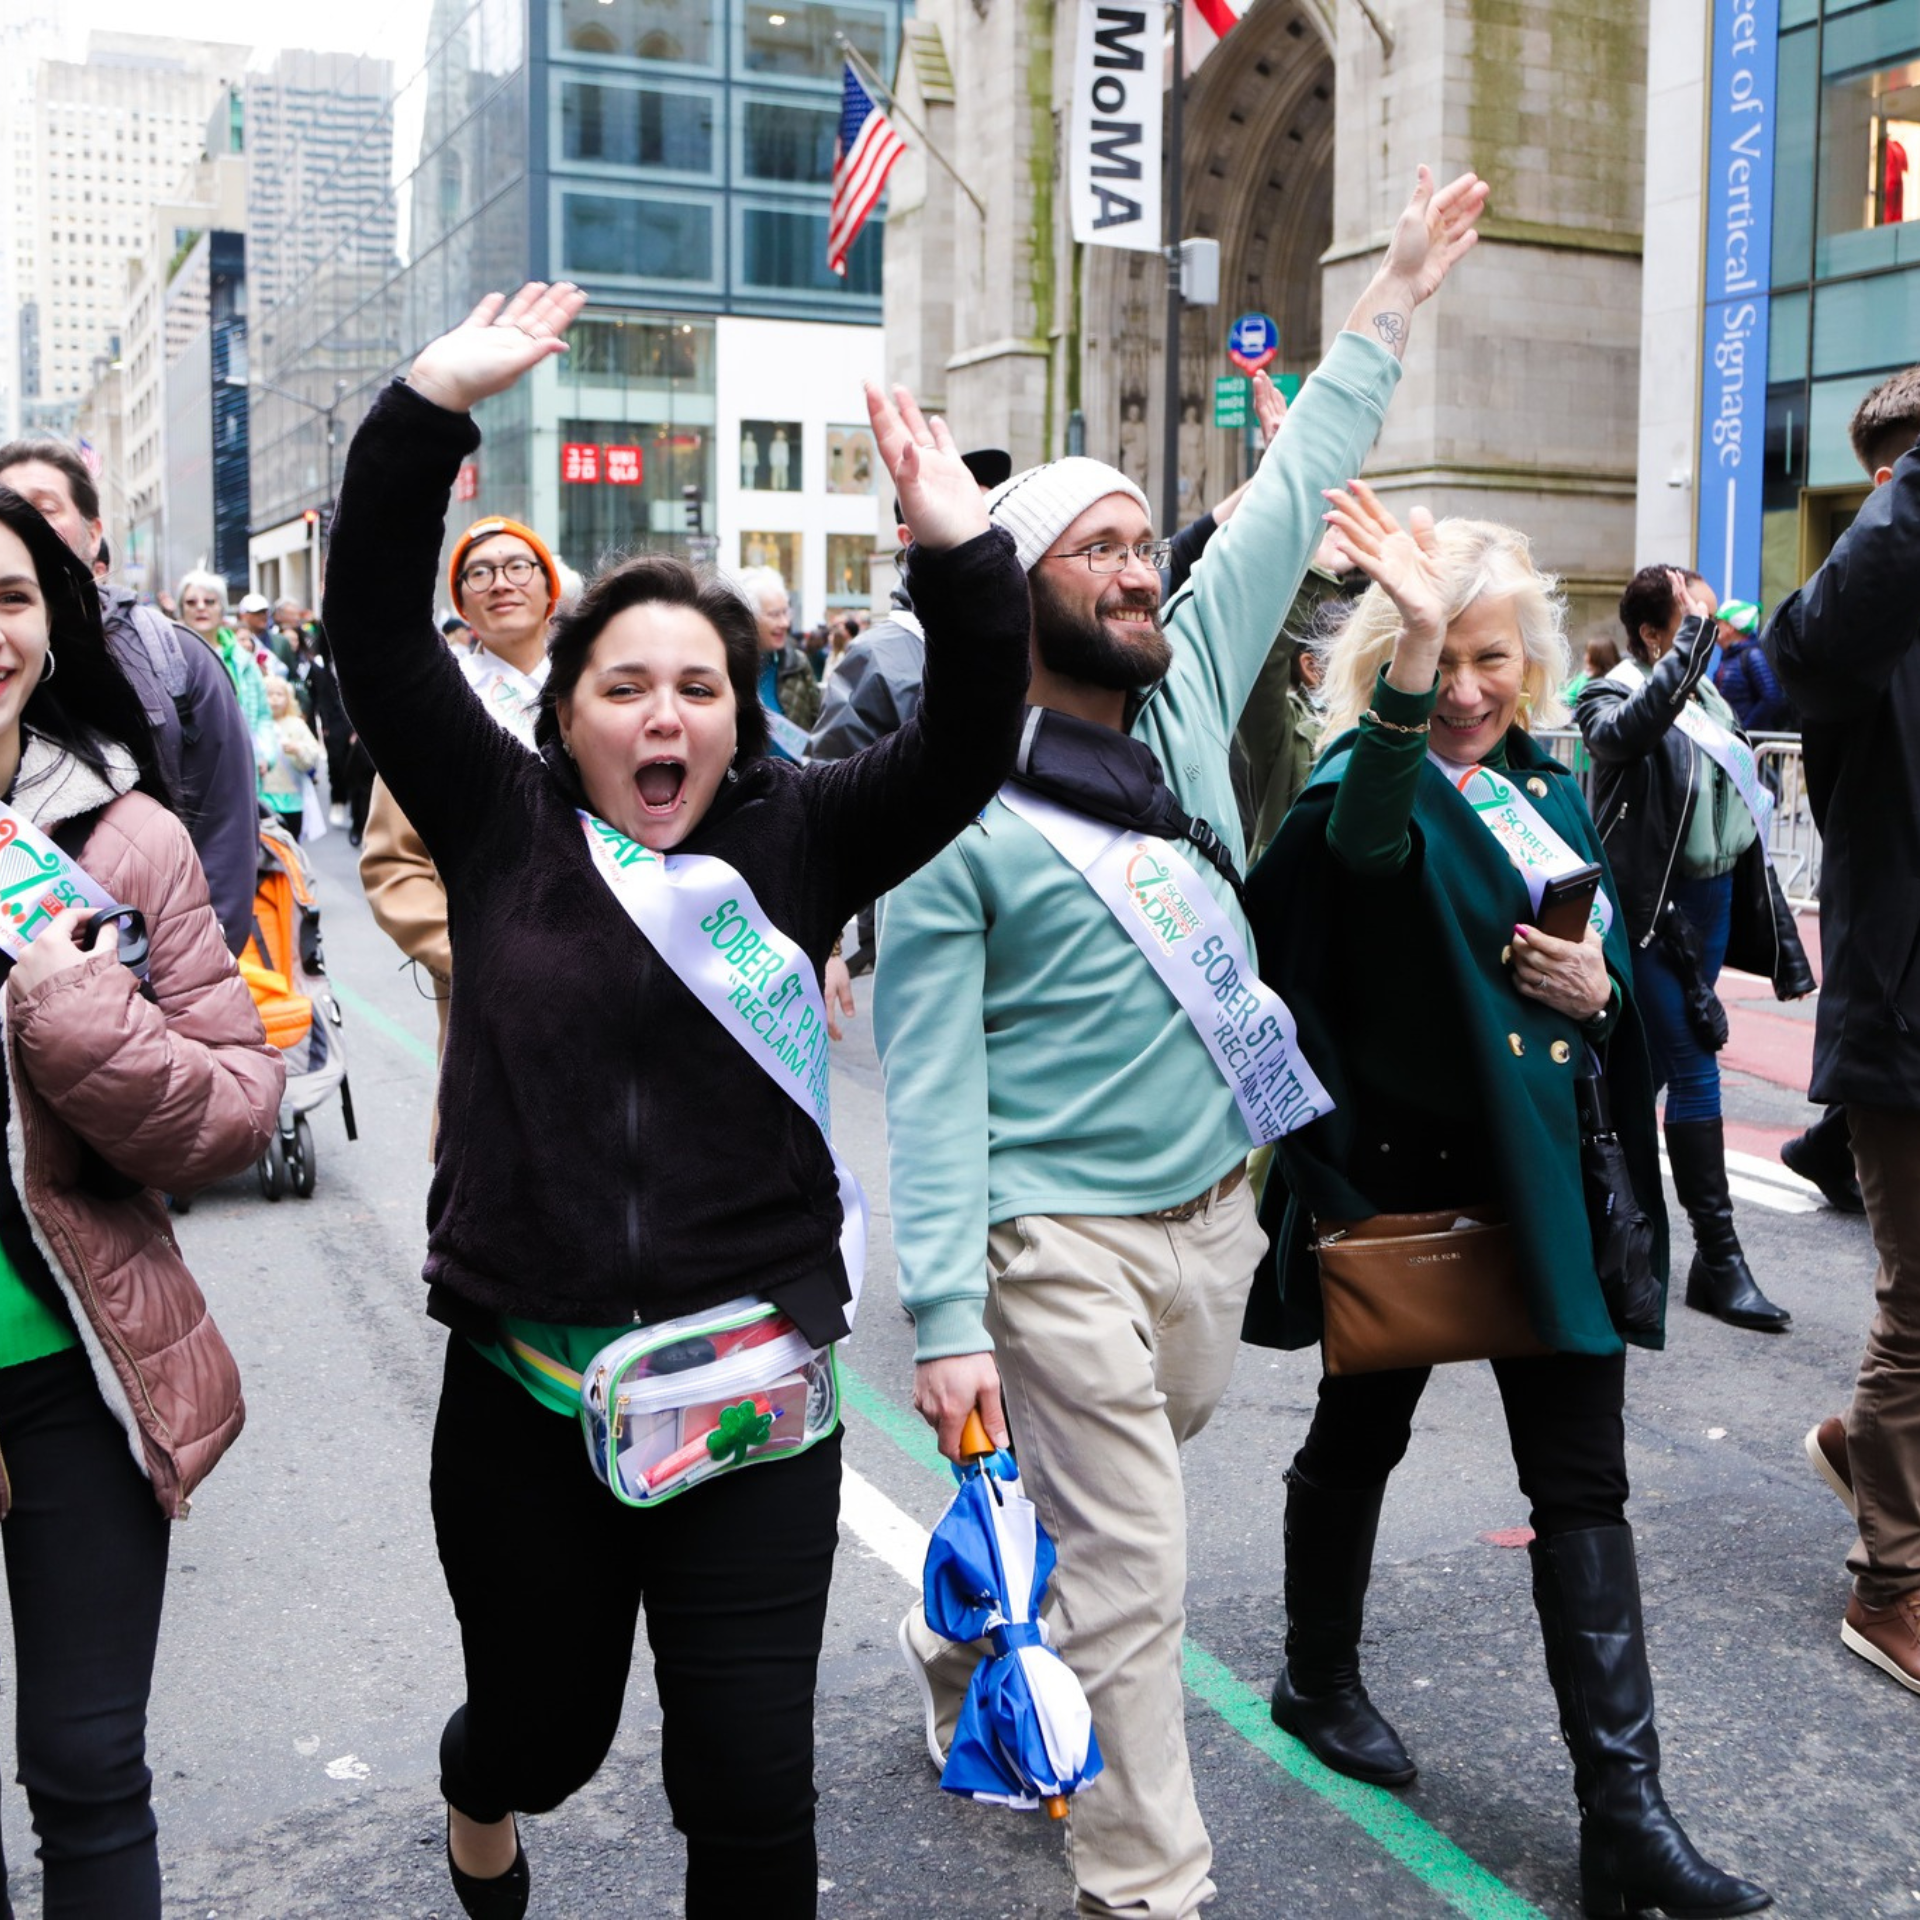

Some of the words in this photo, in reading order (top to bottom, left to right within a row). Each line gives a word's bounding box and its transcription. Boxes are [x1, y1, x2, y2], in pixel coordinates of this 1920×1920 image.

[1091, 8, 1146, 230] MoMA
[1730, 69, 1764, 113] of
[1725, 122, 1762, 293] Vertical
[1712, 303, 1756, 467] Signage
[1500, 807, 1554, 861] SOBER
[700, 899, 785, 993] SOBER
[768, 972, 804, 1028] ST.
[1142, 896, 1186, 944] DAY
[1165, 883, 1200, 929] SOBER
[1191, 935, 1260, 1031] SOBER
[1246, 1015, 1284, 1067] ST.
